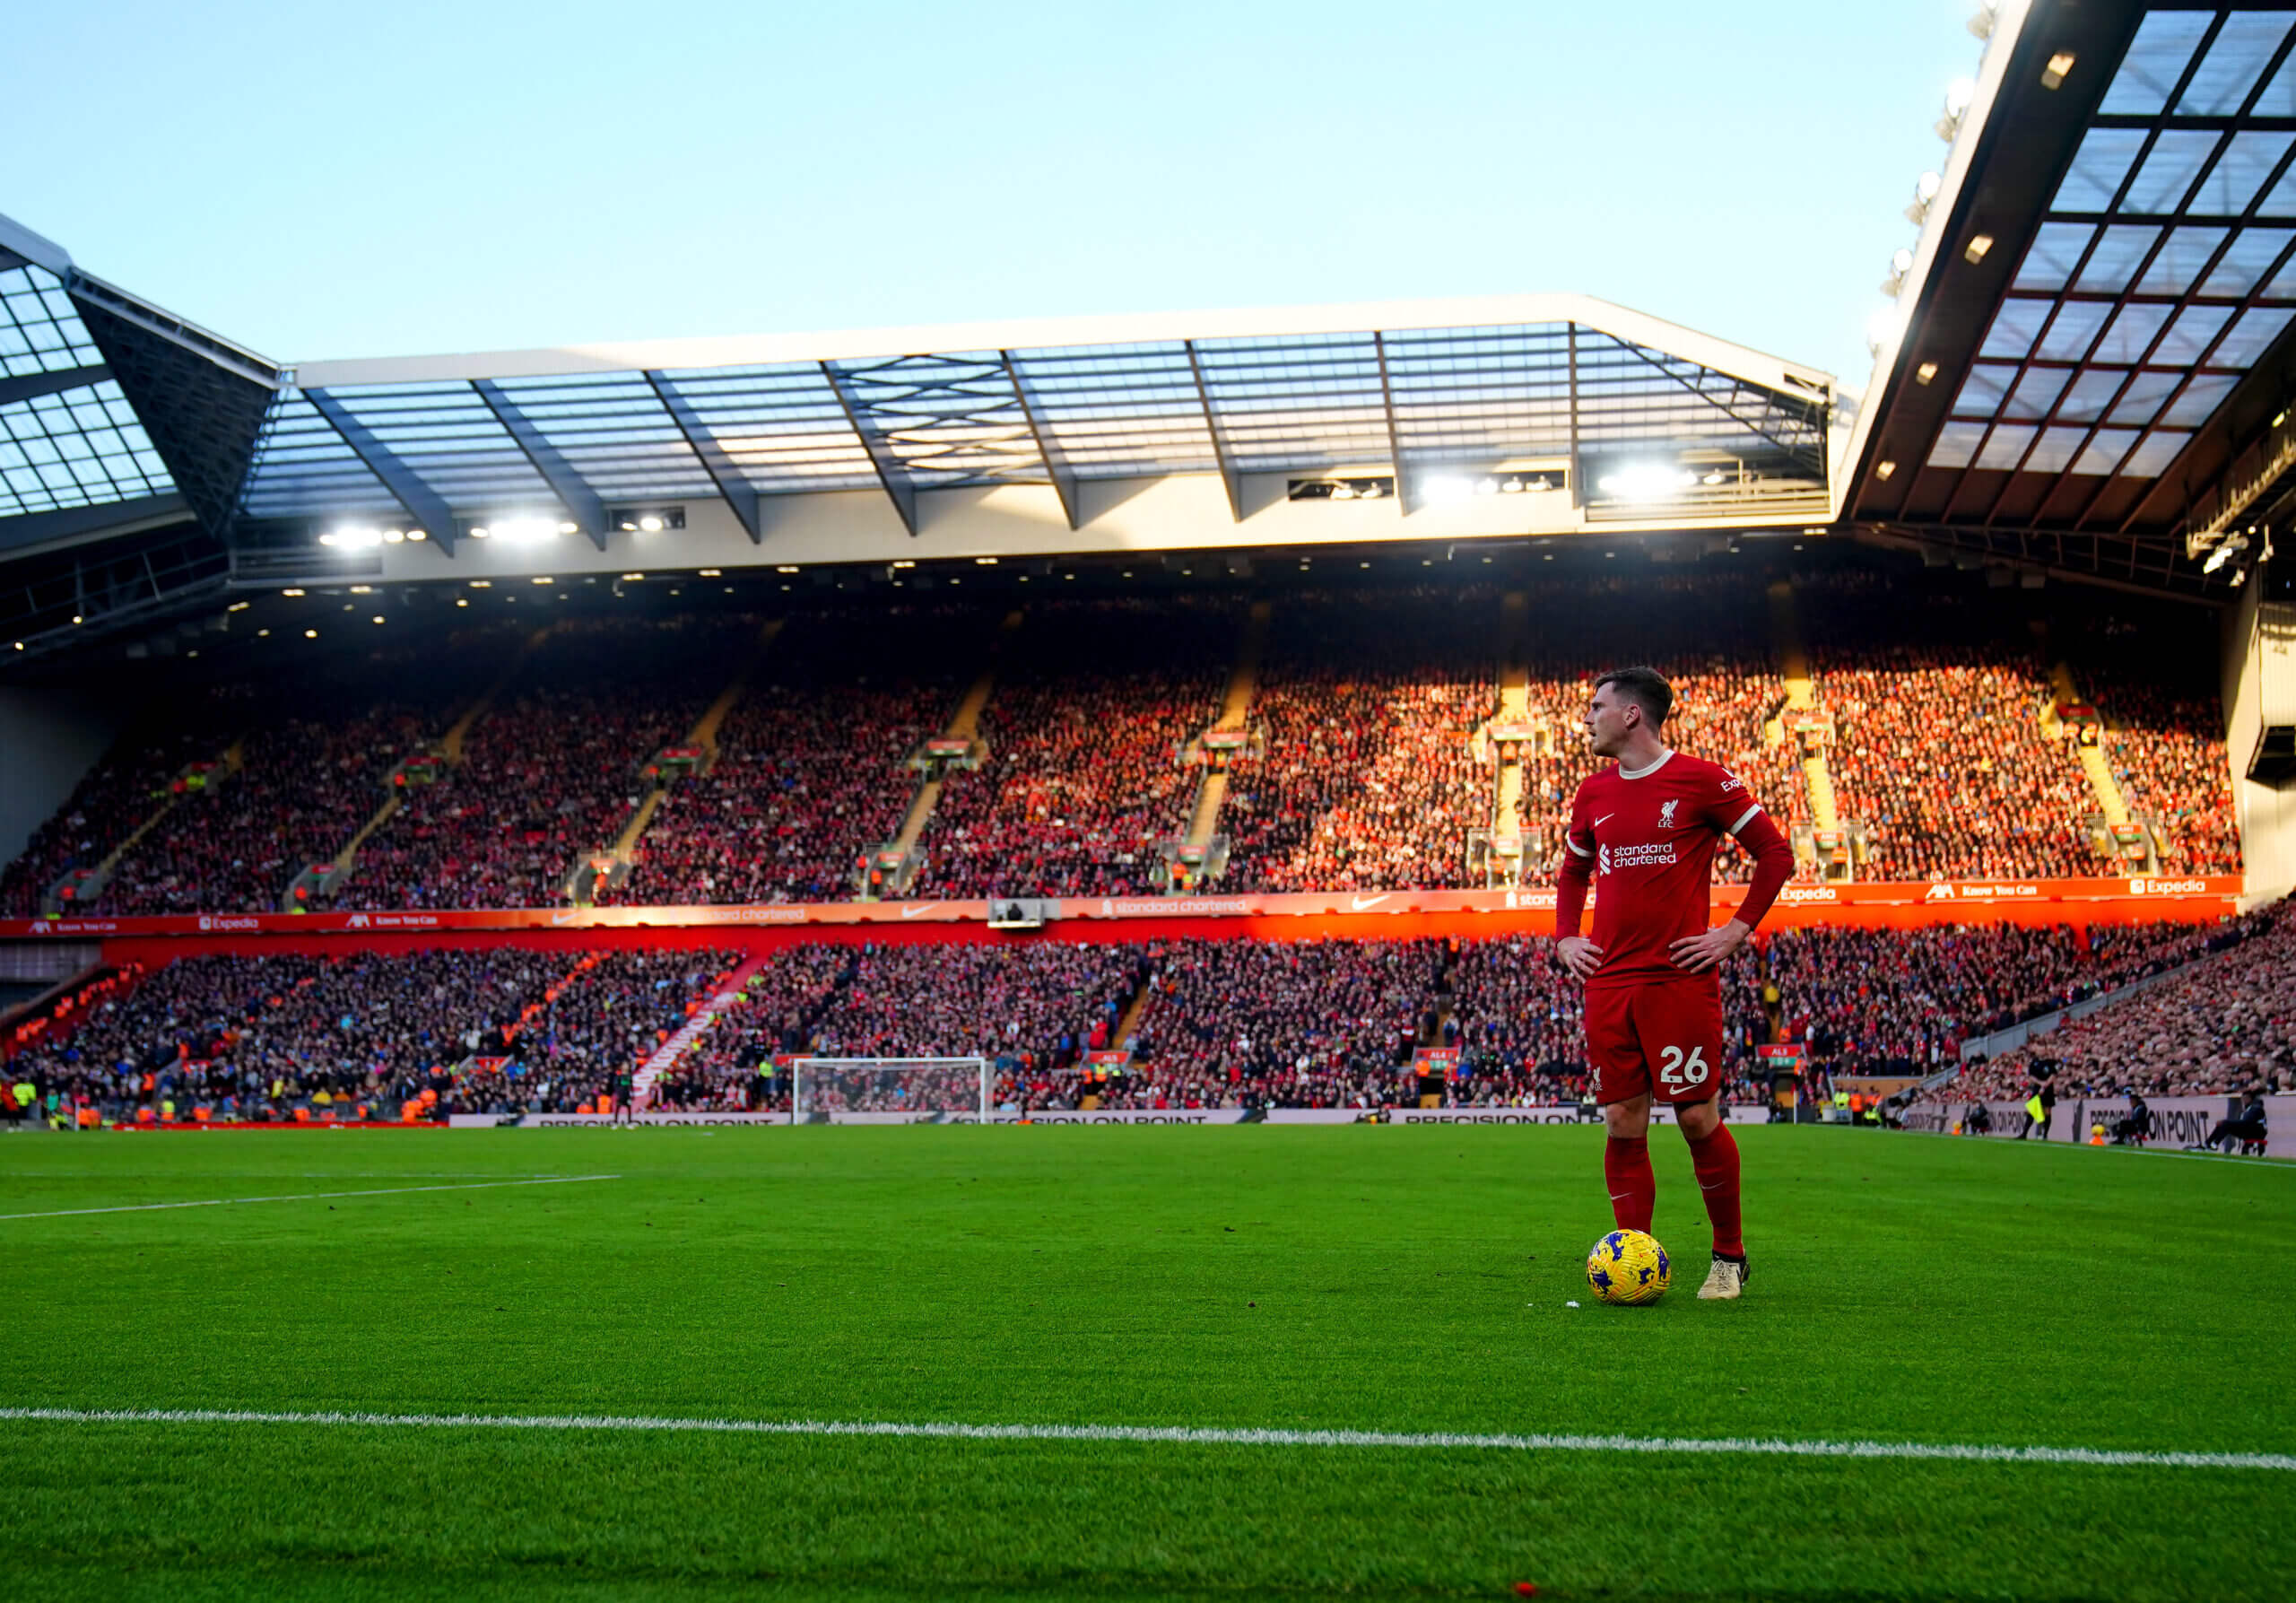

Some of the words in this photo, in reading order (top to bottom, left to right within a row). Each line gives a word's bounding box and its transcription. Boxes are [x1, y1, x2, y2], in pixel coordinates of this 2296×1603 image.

[1613, 842, 1673, 858] standard
[1613, 852, 1677, 868] chartered
[1962, 885, 1993, 896] Know
[1994, 884, 2015, 896] You
[2016, 884, 2037, 895] Can
[2147, 879, 2205, 894] Expedia
[1780, 887, 1836, 901] Expedia
[1116, 900, 1178, 913] standard
[1179, 899, 1246, 913] chartered
[742, 908, 804, 920] chartered
[213, 917, 259, 930] Expedia
[1660, 1045, 1709, 1084] 26
[2147, 1111, 2166, 1140] ON
[2168, 1111, 2209, 1142] POINT
